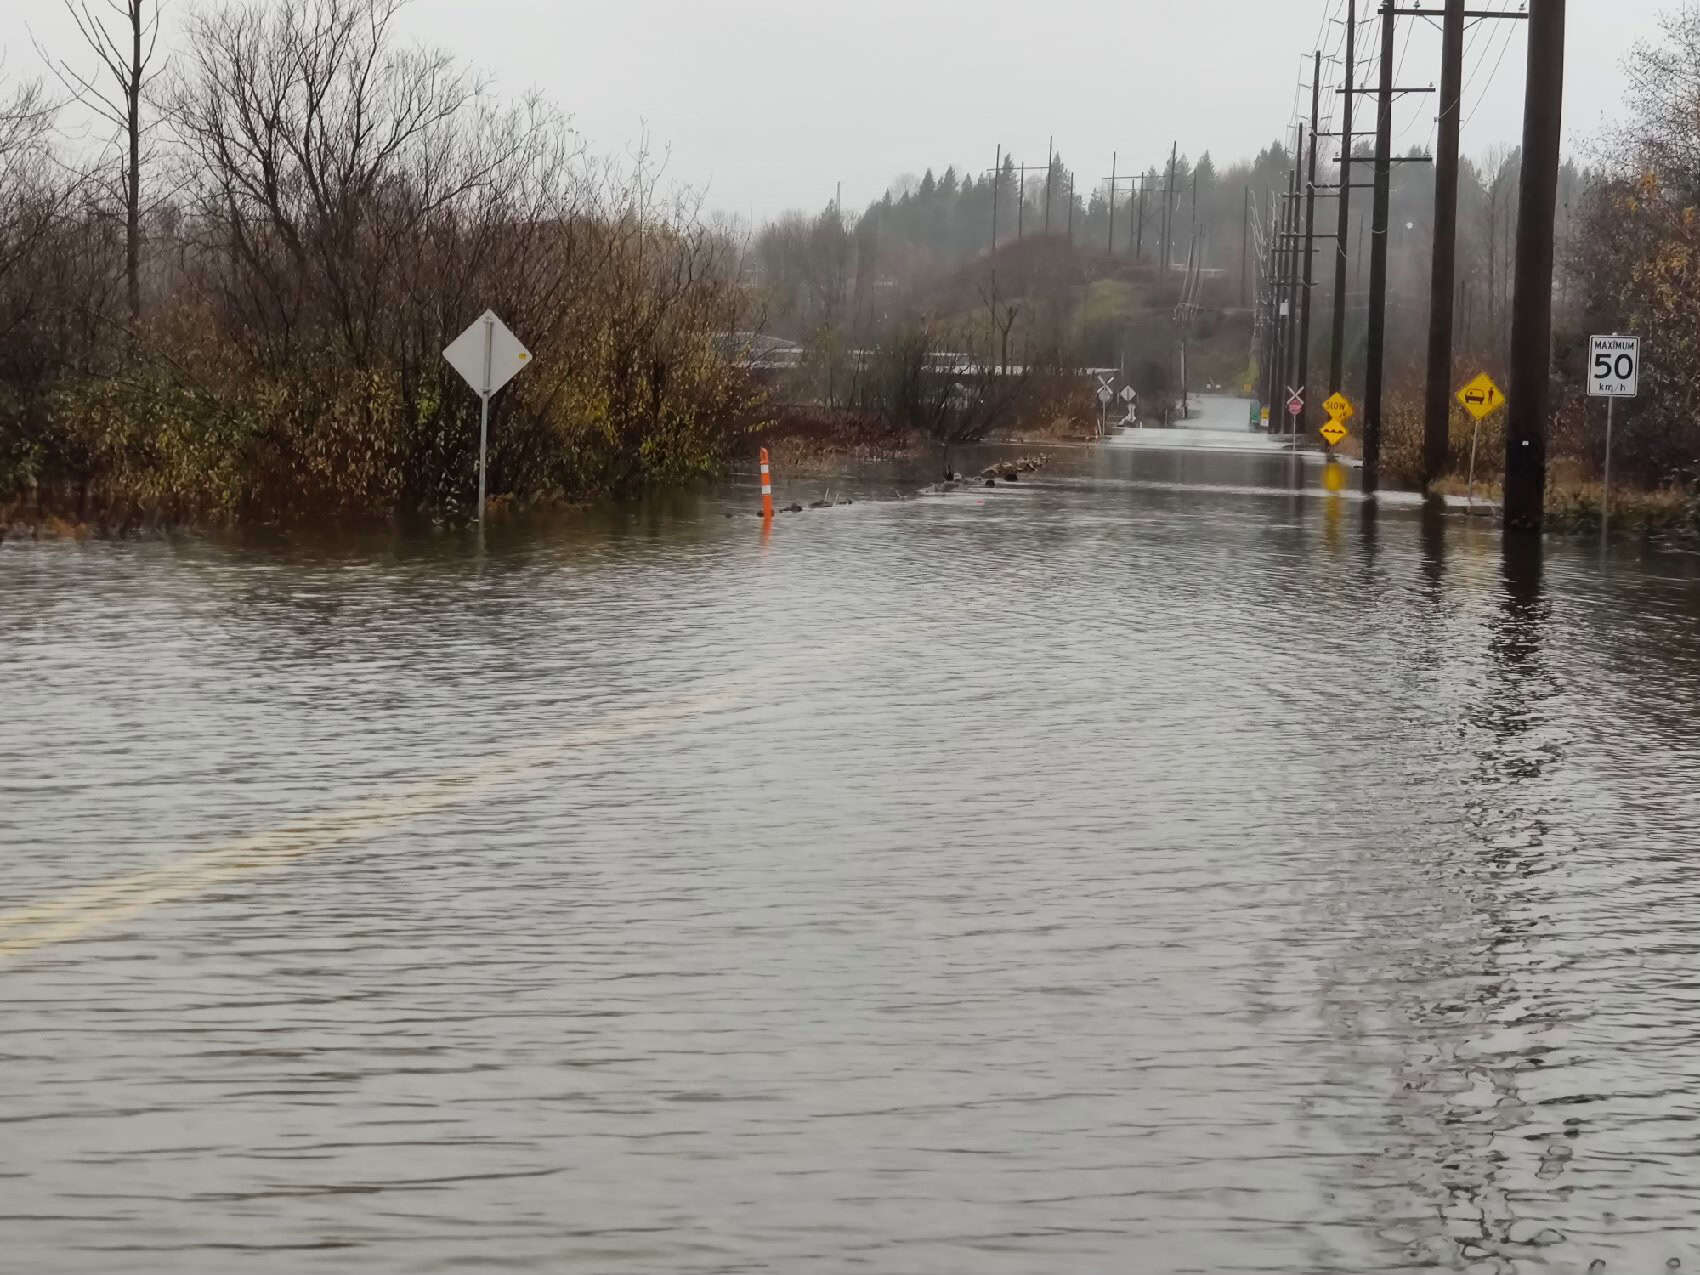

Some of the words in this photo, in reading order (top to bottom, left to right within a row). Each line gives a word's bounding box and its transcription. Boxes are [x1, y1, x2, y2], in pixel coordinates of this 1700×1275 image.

[1594, 341, 1634, 350] MAXIMUM
[1594, 354, 1633, 379] 50
[1599, 382, 1626, 392] km/h
